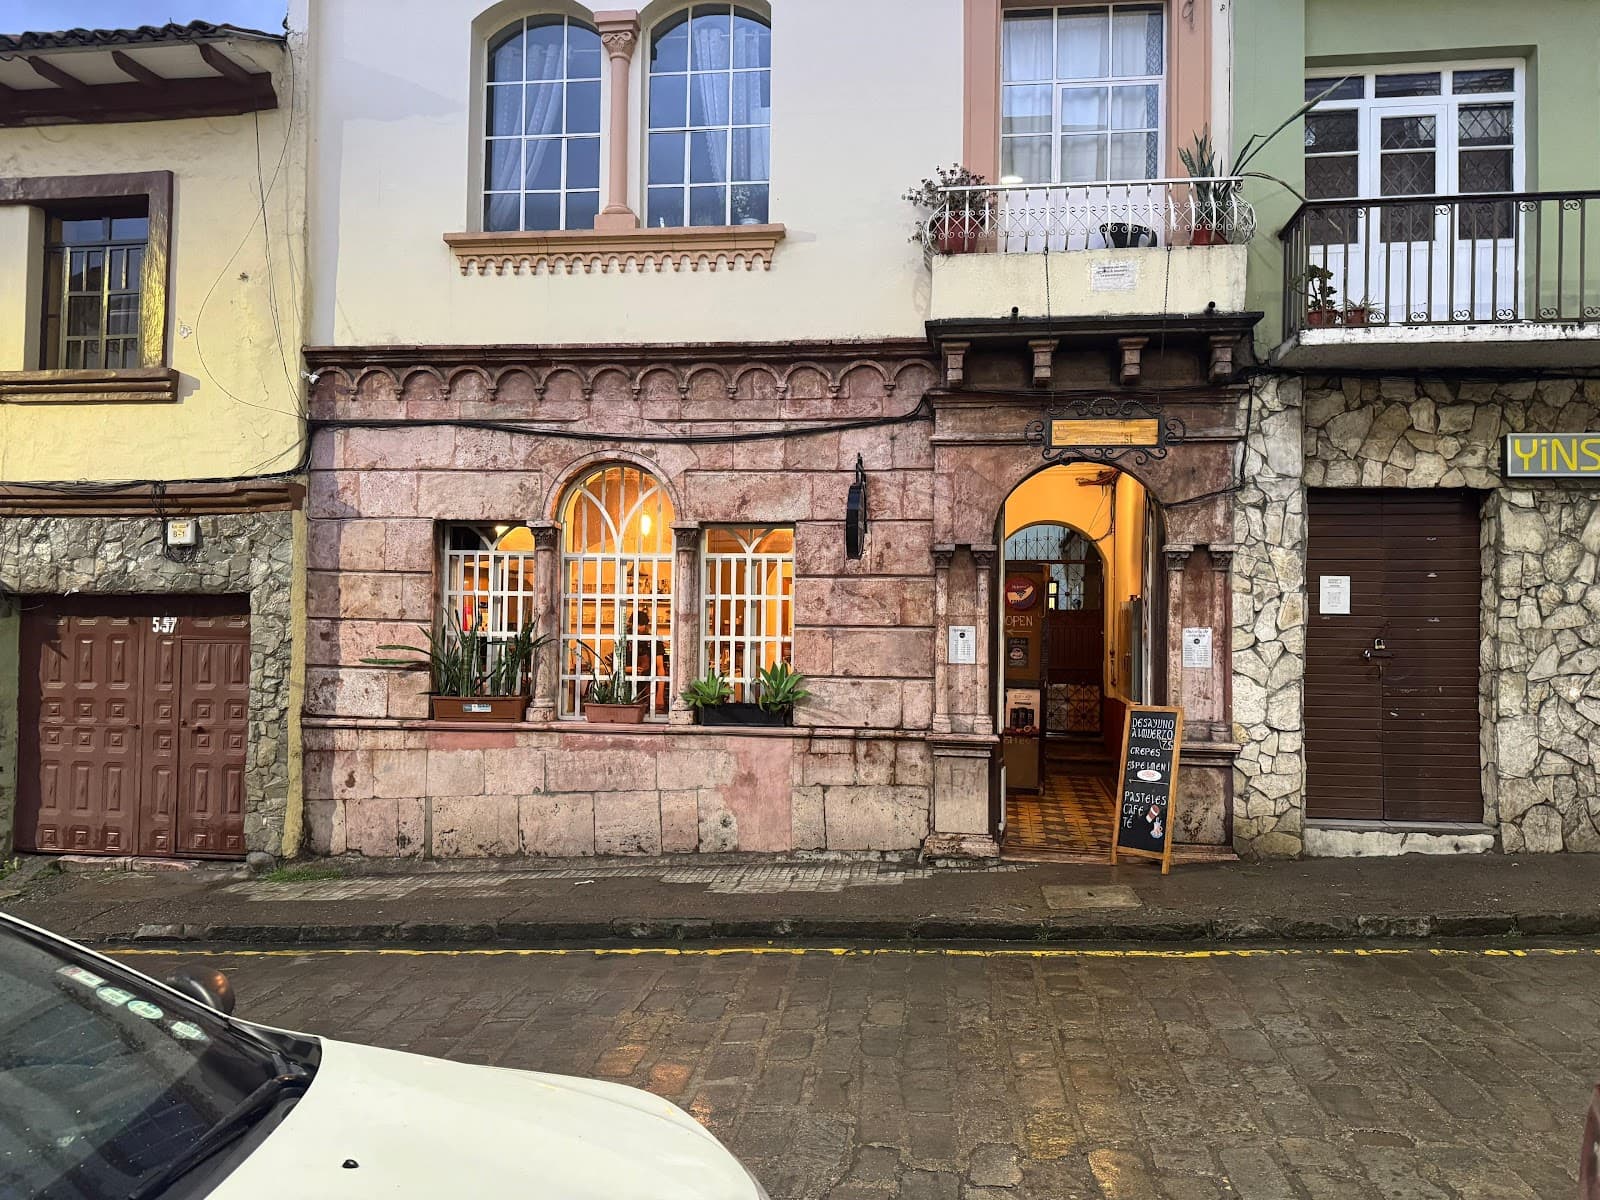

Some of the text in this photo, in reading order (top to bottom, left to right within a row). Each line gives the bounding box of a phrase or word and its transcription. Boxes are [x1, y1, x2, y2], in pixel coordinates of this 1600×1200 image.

[1005, 615, 1033, 627] OPEN
[1132, 718, 1174, 730] DESAYUNO
[1131, 728, 1173, 740] ALMUERZO
[1130, 747, 1161, 757] CREPES
[1124, 791, 1167, 805] PASTELES
[1122, 815, 1133, 828] TÉ
